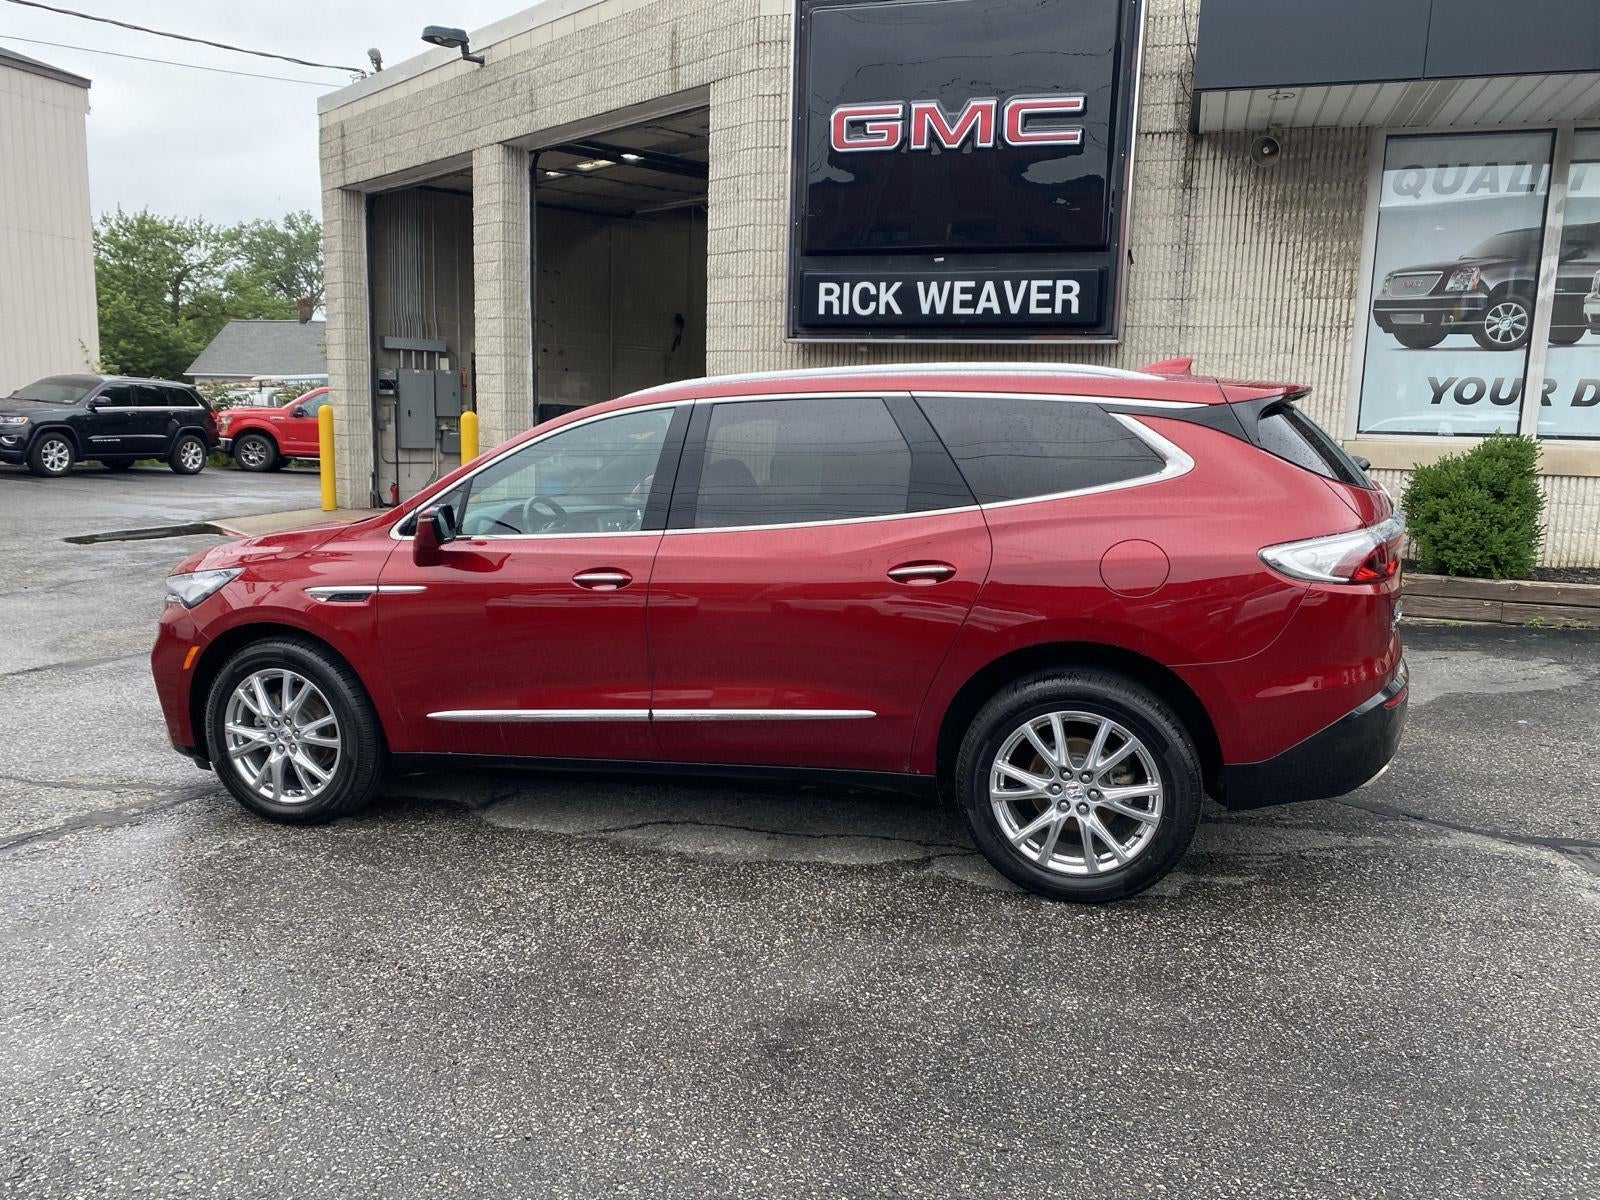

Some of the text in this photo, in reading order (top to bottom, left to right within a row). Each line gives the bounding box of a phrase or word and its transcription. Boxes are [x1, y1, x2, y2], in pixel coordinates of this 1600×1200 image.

[830, 95, 1085, 151] GMC
[817, 279, 1081, 316] RICK WEAVER
[1427, 376, 1558, 407] YOUR
